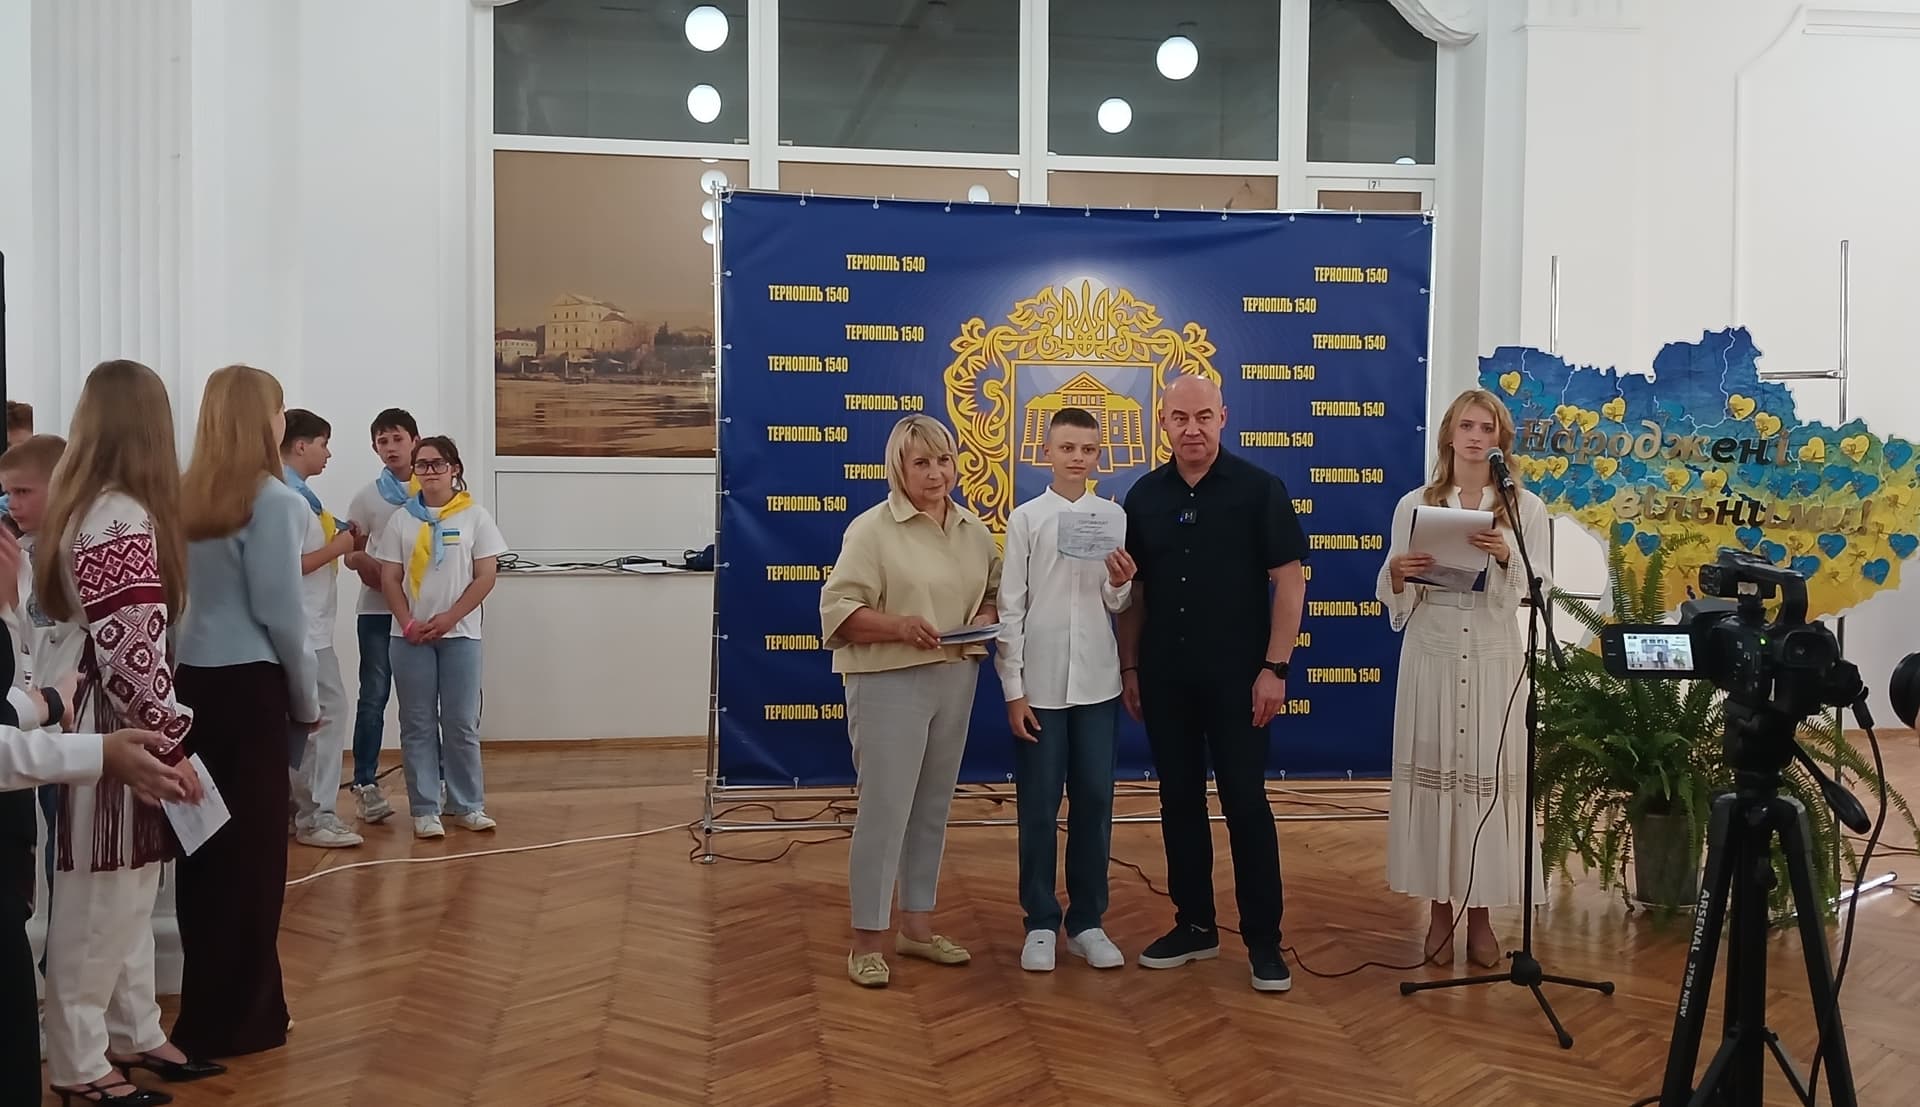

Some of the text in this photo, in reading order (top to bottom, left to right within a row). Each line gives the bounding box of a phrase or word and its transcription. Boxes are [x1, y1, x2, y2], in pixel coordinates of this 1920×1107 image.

[847, 254, 926, 272] ТЕРНОПІЛЬ 1540
[1315, 266, 1388, 283] ТЕРНОПІЛЬ 1540
[768, 285, 850, 302] ТЕРНОПІЛЬ 1540
[1243, 296, 1317, 313] ТЕРНОПІЛЬ 1540
[846, 324, 925, 342] ТЕРНОПІЛЬ 1540
[1313, 334, 1386, 350] ТЕРНОПІЛЬ 1540
[768, 355, 849, 372] ТЕРНОПІЛЬ 1540
[1242, 364, 1316, 380] ТЕРНОПІЛЬ 1540
[845, 394, 924, 411] ТЕРНОПІЛЬ 1540
[1311, 401, 1385, 417] ТЕРНОПІЛЬ 1540
[767, 425, 848, 442] ТЕРНОПІЛЬ 1540
[1240, 431, 1314, 447] ТЕРНОПІЛЬ 1540
[1519, 418, 1791, 466] Народжені
[844, 464, 887, 479] ТЕРНОПІ
[1310, 467, 1384, 484] ТЕРНОПІЛЬ 1540
[767, 495, 847, 512] ТЕРНОПІЛЬ 1540
[1309, 534, 1383, 550] ТЕРНОПІЛЬ 1540
[767, 565, 820, 581] ТЕРНОПІЛЬ
[1308, 601, 1382, 617] ТЕРНОПІЛЬ 1540
[765, 635, 819, 650] ТЕРНОПІЛЬ
[1307, 667, 1381, 683] ТЕРНОПІЛЬ 1540
[765, 704, 844, 720] ТЕРНОПІЛЬ 1540
[1287, 699, 1310, 714] 1540
[1691, 888, 1710, 953] ARSENAL
[1680, 989, 1691, 1018] NEW
